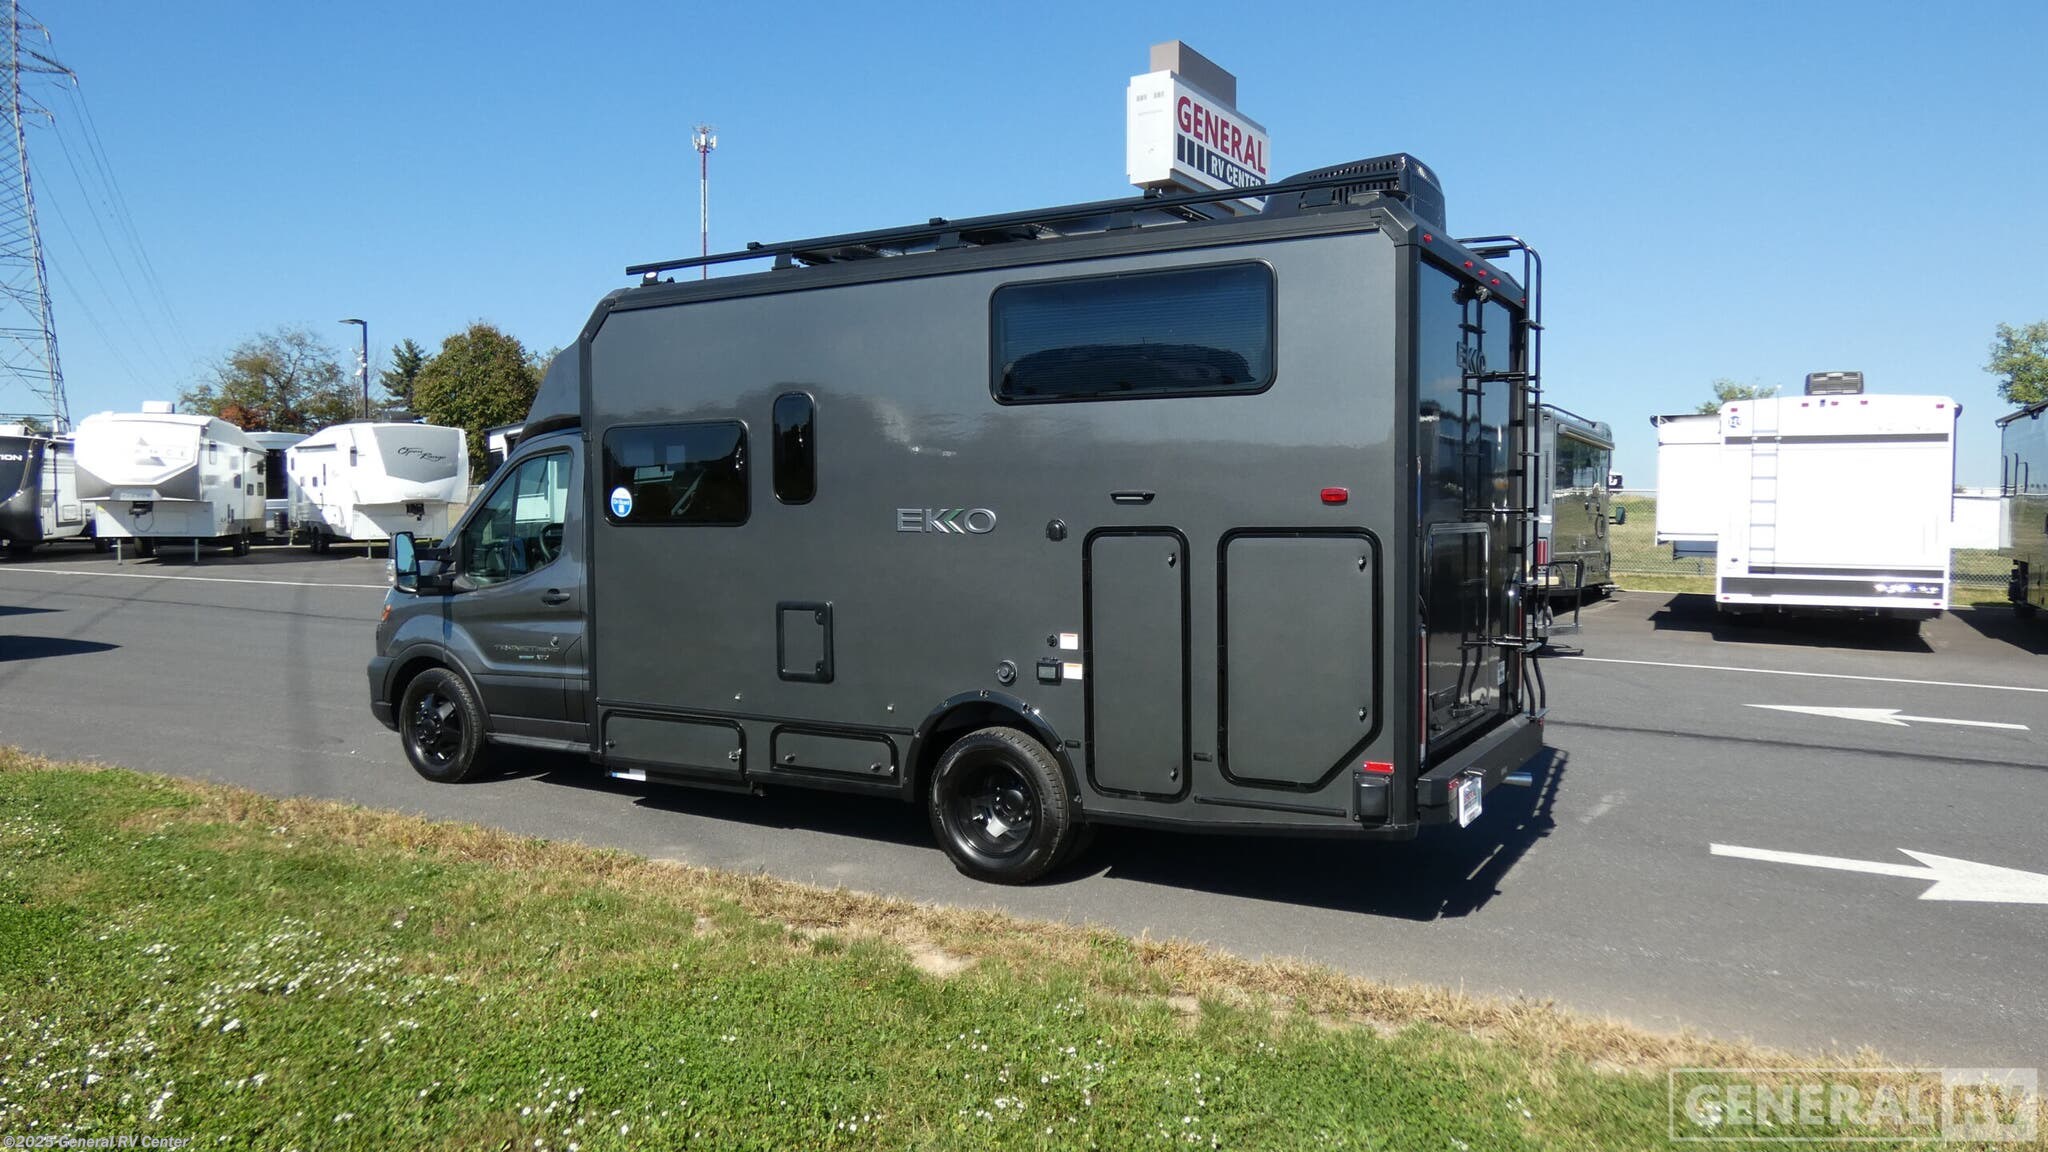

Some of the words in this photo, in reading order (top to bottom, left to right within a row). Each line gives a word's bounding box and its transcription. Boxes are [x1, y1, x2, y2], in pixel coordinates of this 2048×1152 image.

[1177, 96, 1266, 175] GENERAL
[1211, 155, 1225, 178] RV
[896, 508, 997, 534] EKKO
